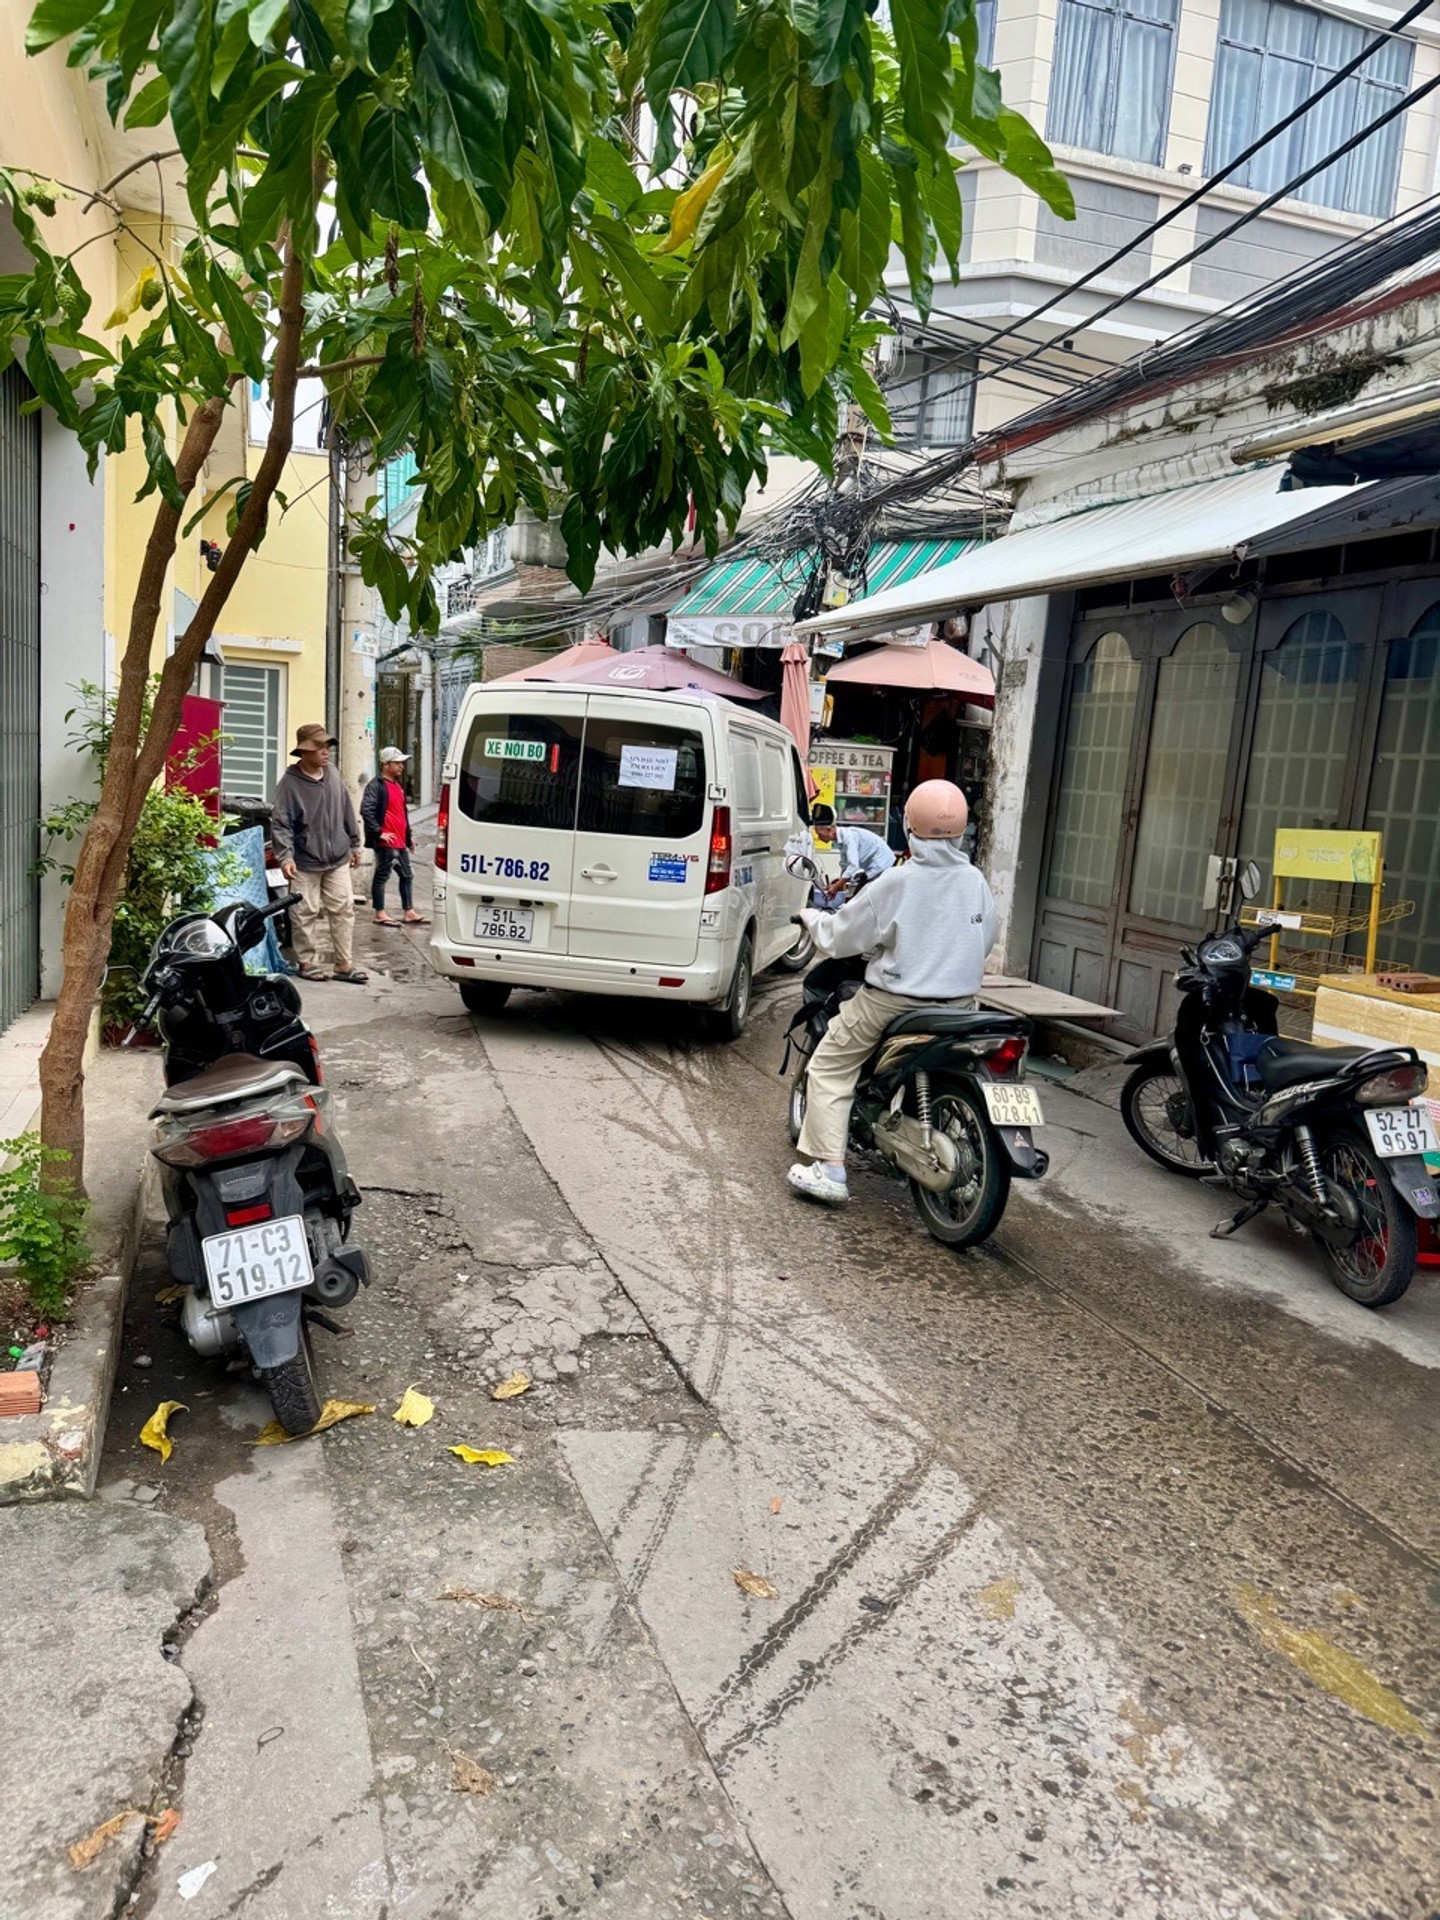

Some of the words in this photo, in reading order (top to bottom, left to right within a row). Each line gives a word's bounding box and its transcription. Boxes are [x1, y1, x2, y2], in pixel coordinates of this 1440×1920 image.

[487, 741, 502, 755] XE
[849, 753, 857, 766] &
[862, 754, 884, 767] TEA
[460, 853, 550, 882] 51L-786.82
[492, 909, 517, 924] 51L
[481, 922, 526, 939] 786.82
[991, 1105, 1041, 1123] 028.41
[1382, 1129, 1428, 1152] 9697
[217, 1224, 291, 1269] 71-C3
[216, 1253, 305, 1301] 519.12
